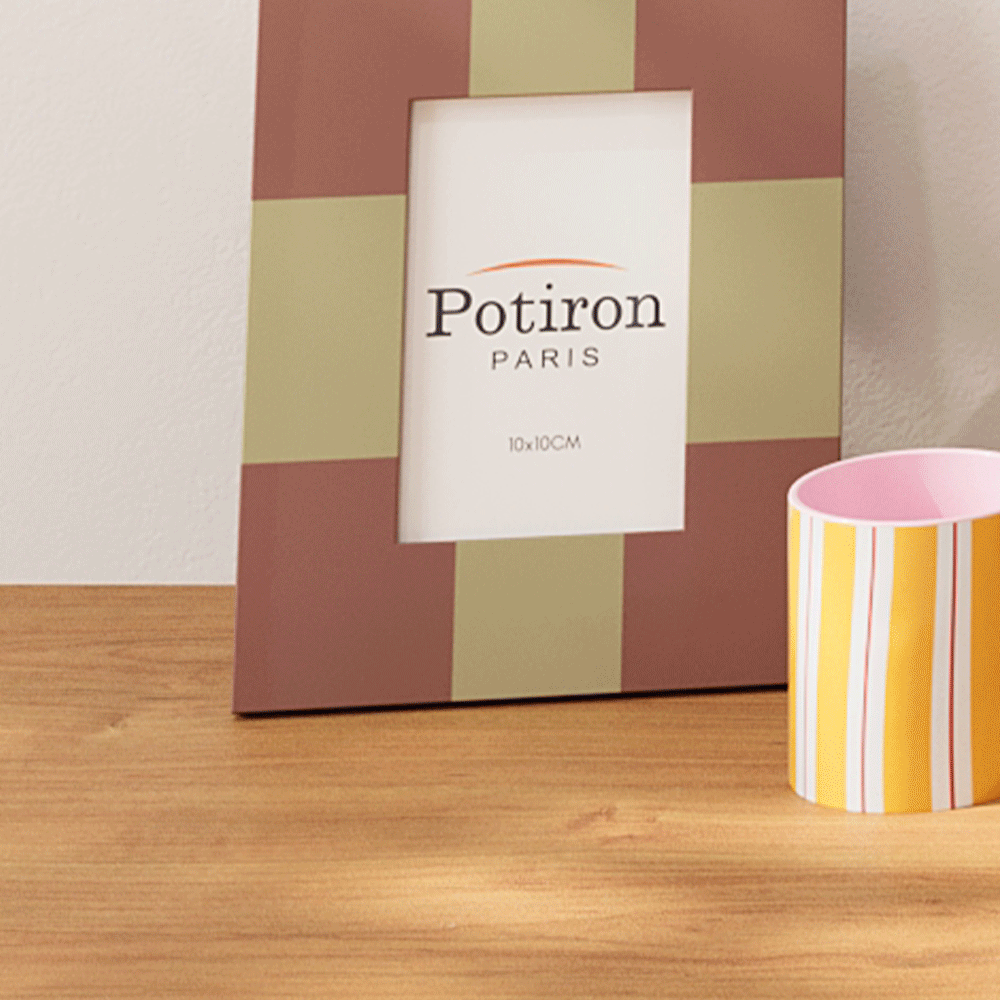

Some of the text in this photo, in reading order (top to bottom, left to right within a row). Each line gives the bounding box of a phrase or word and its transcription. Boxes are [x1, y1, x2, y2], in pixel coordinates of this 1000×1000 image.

[426, 283, 666, 337] Potiron
[491, 347, 600, 370] PARIS
[508, 435, 582, 452] 10x10CM
